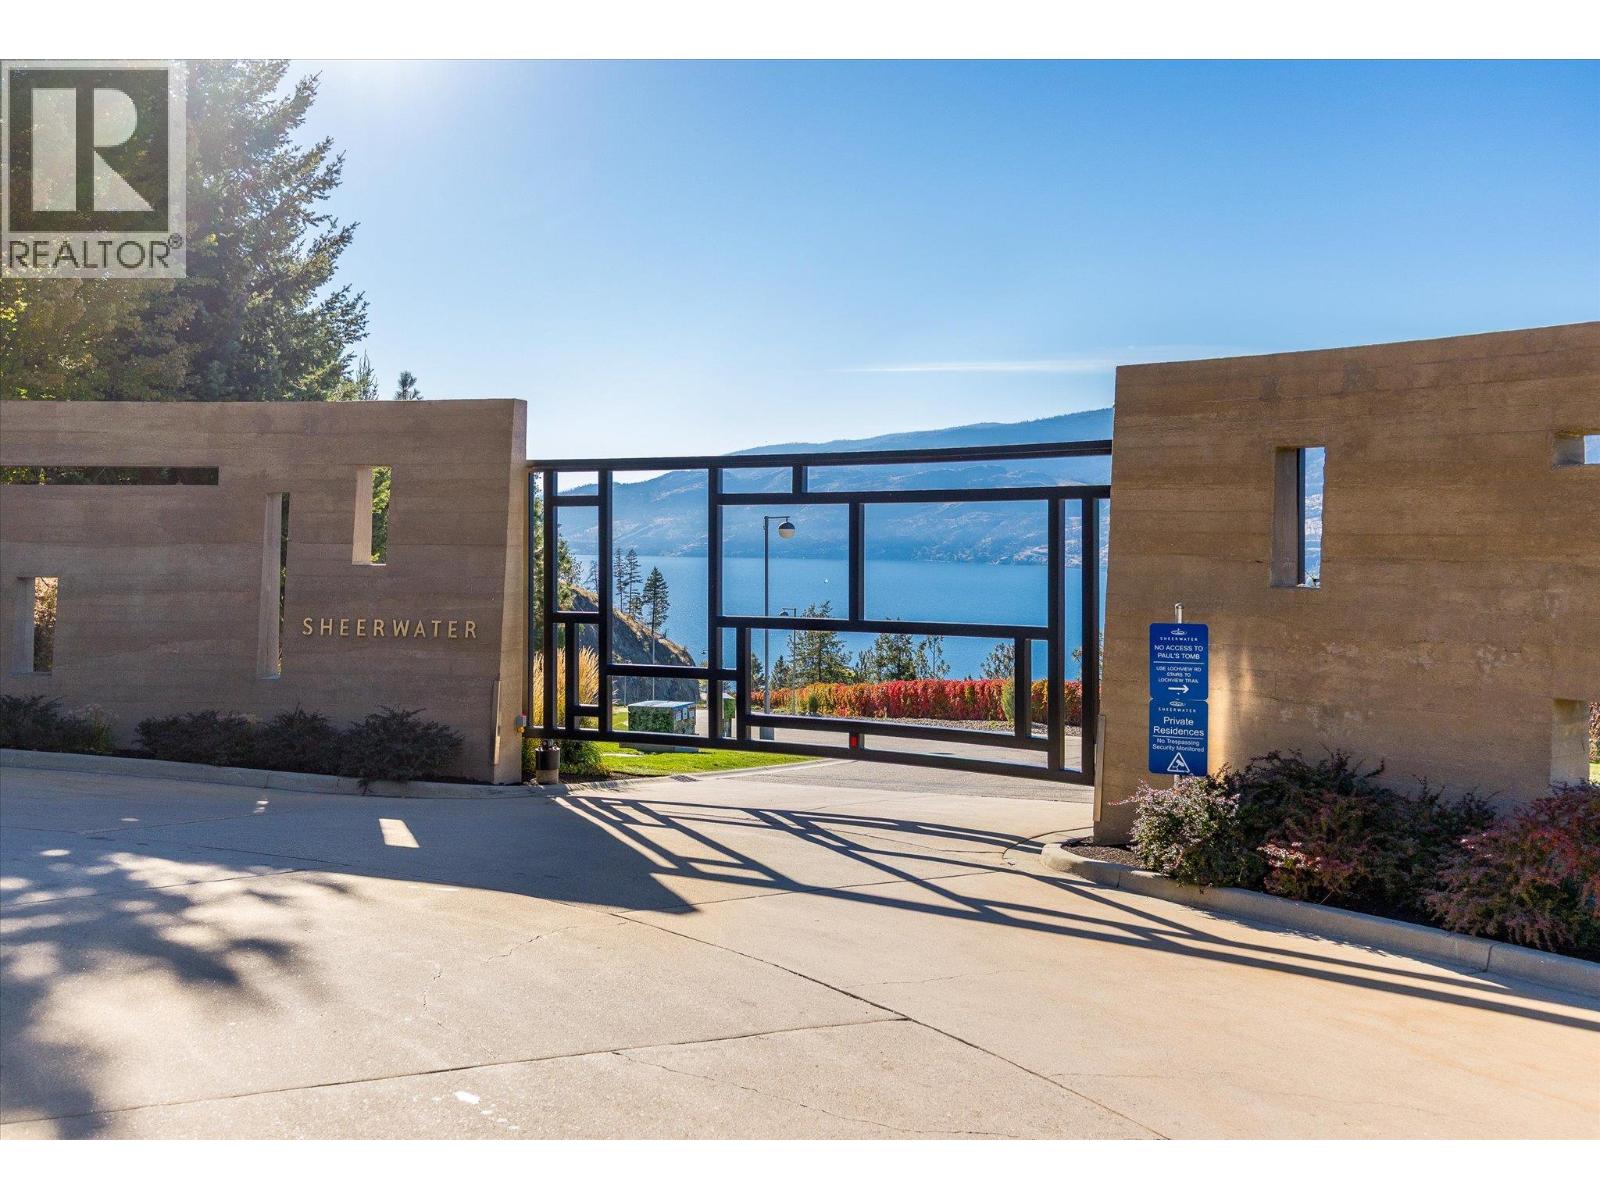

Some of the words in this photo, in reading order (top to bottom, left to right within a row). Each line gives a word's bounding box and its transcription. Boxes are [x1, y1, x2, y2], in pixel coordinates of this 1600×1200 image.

[302, 617, 477, 638] SHEERWATER
[1163, 716, 1194, 726] Private
[1153, 726, 1204, 736] Residences
[1152, 743, 1175, 751] Security
[1167, 738, 1200, 747] Trespassing
